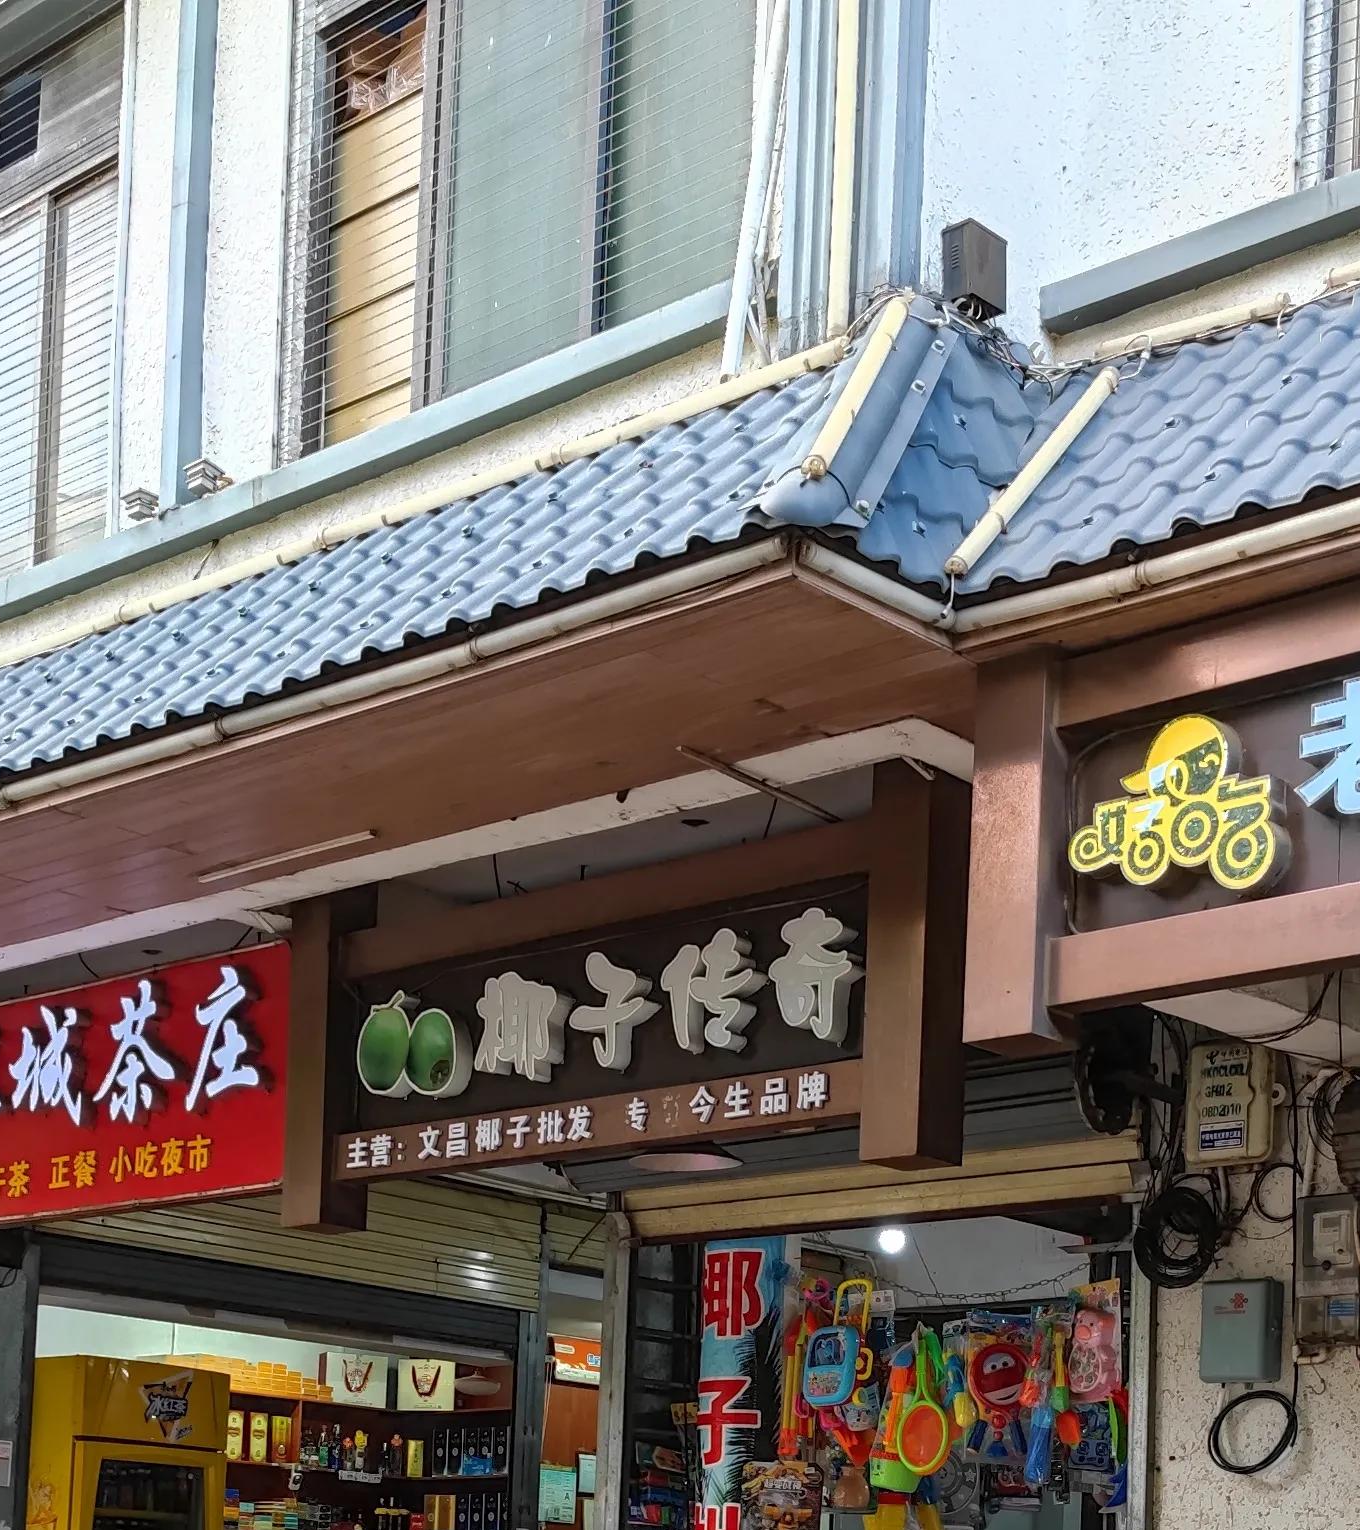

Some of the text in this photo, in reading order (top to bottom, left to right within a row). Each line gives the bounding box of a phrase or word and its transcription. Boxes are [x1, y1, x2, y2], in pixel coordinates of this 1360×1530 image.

[475, 907, 856, 1080] 椰子传奇
[49, 1151, 97, 1190] 正餐
[110, 1134, 212, 1183] 小吃夜市
